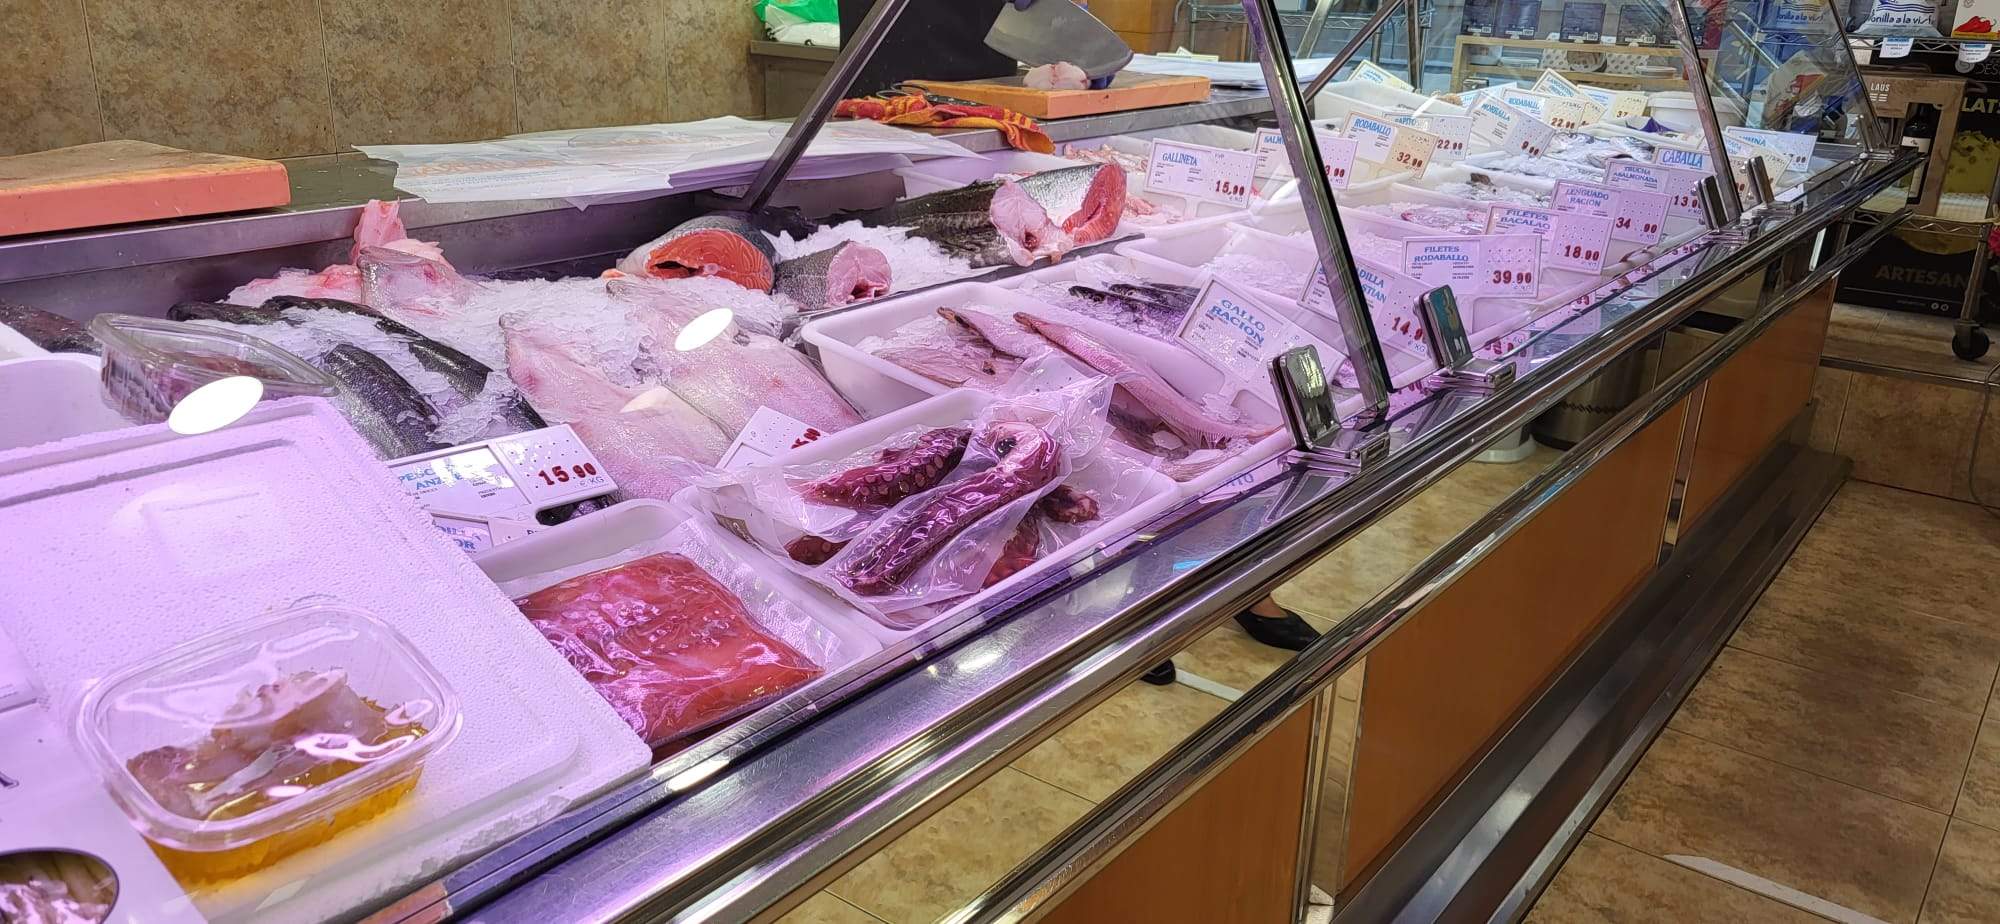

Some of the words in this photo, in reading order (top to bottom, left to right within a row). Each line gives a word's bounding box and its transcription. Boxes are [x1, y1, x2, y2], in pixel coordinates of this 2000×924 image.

[1354, 117, 1392, 136] RODABALLO
[1162, 152, 1198, 166] GALLINETA
[1662, 150, 1704, 169] CABALLA
[1566, 186, 1610, 201] LENGUADO
[1569, 196, 1602, 208] RACION
[1505, 208, 1549, 222] FILETES
[1500, 216, 1551, 231] BACALAO
[1424, 245, 1460, 254] FILETES
[1413, 254, 1469, 263] RODABALLO
[1356, 266, 1385, 289] DILLA
[1361, 282, 1388, 304] STIAN
[1220, 298, 1267, 332] GALLO
[1210, 304, 1265, 345] RACION
